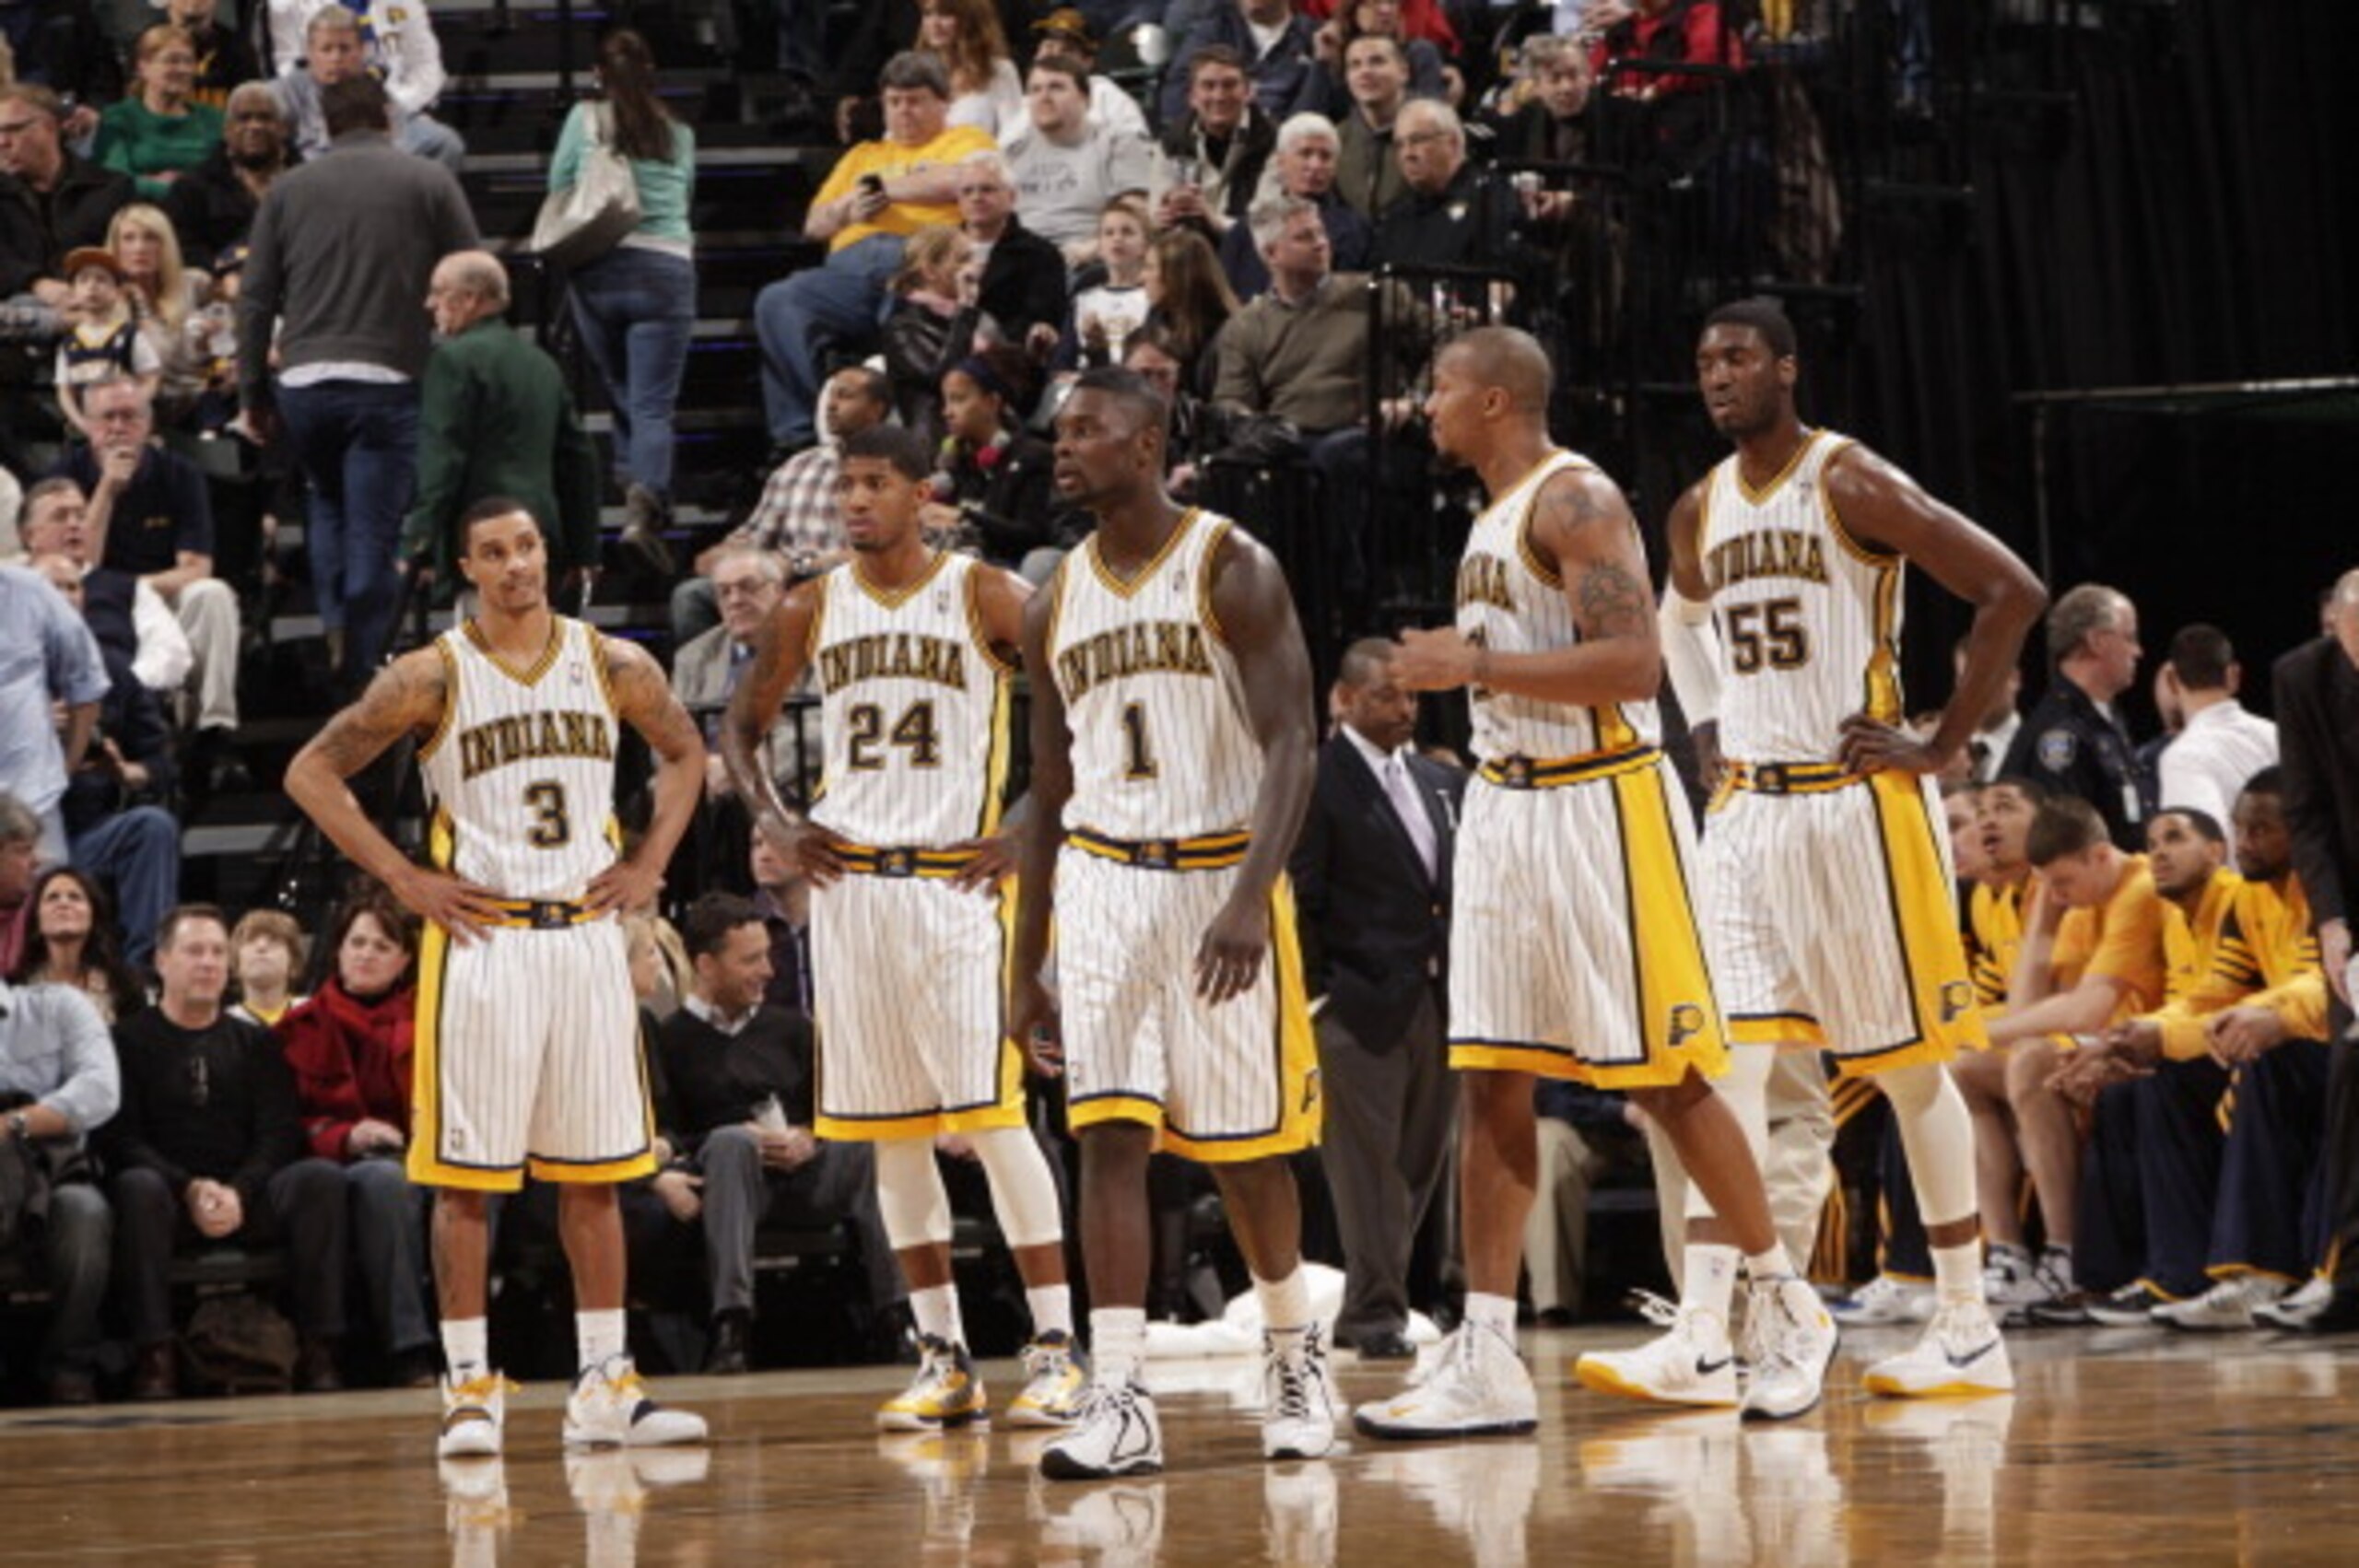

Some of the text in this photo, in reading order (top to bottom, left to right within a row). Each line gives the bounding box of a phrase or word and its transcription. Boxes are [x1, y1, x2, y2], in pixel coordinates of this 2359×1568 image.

[819, 632, 967, 696] INDIANA
[1058, 621, 1214, 707] INDIANA
[1726, 597, 1808, 674] 55
[459, 709, 611, 781] INDIANA
[848, 697, 943, 771] 24
[1122, 698, 1159, 781] 1
[522, 778, 569, 848] 3
